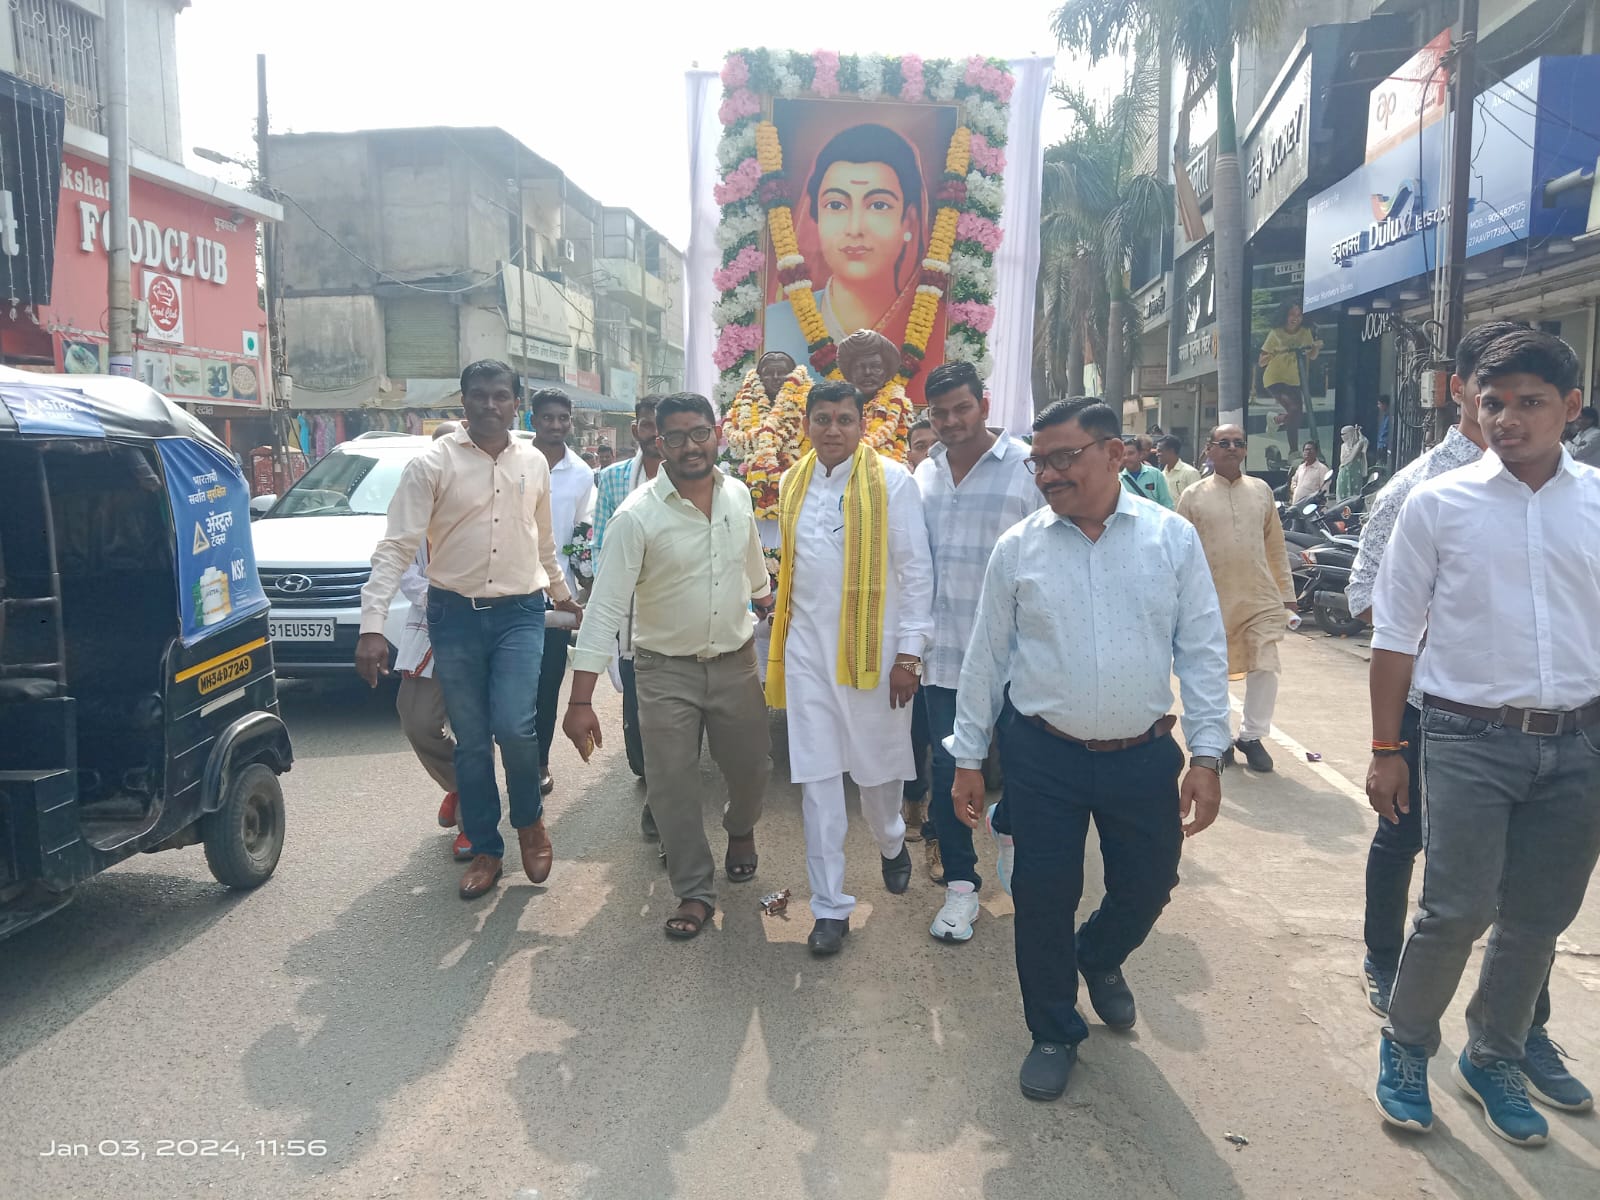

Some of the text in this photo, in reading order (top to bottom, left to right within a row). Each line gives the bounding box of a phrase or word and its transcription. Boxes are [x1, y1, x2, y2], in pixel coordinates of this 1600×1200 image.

[1264, 103, 1303, 181] JOCKEY
[60, 162, 109, 201] ksha
[1368, 216, 1406, 251] Dulux
[1361, 311, 1395, 342] JOCK
[269, 623, 332, 637] 31EU5579
